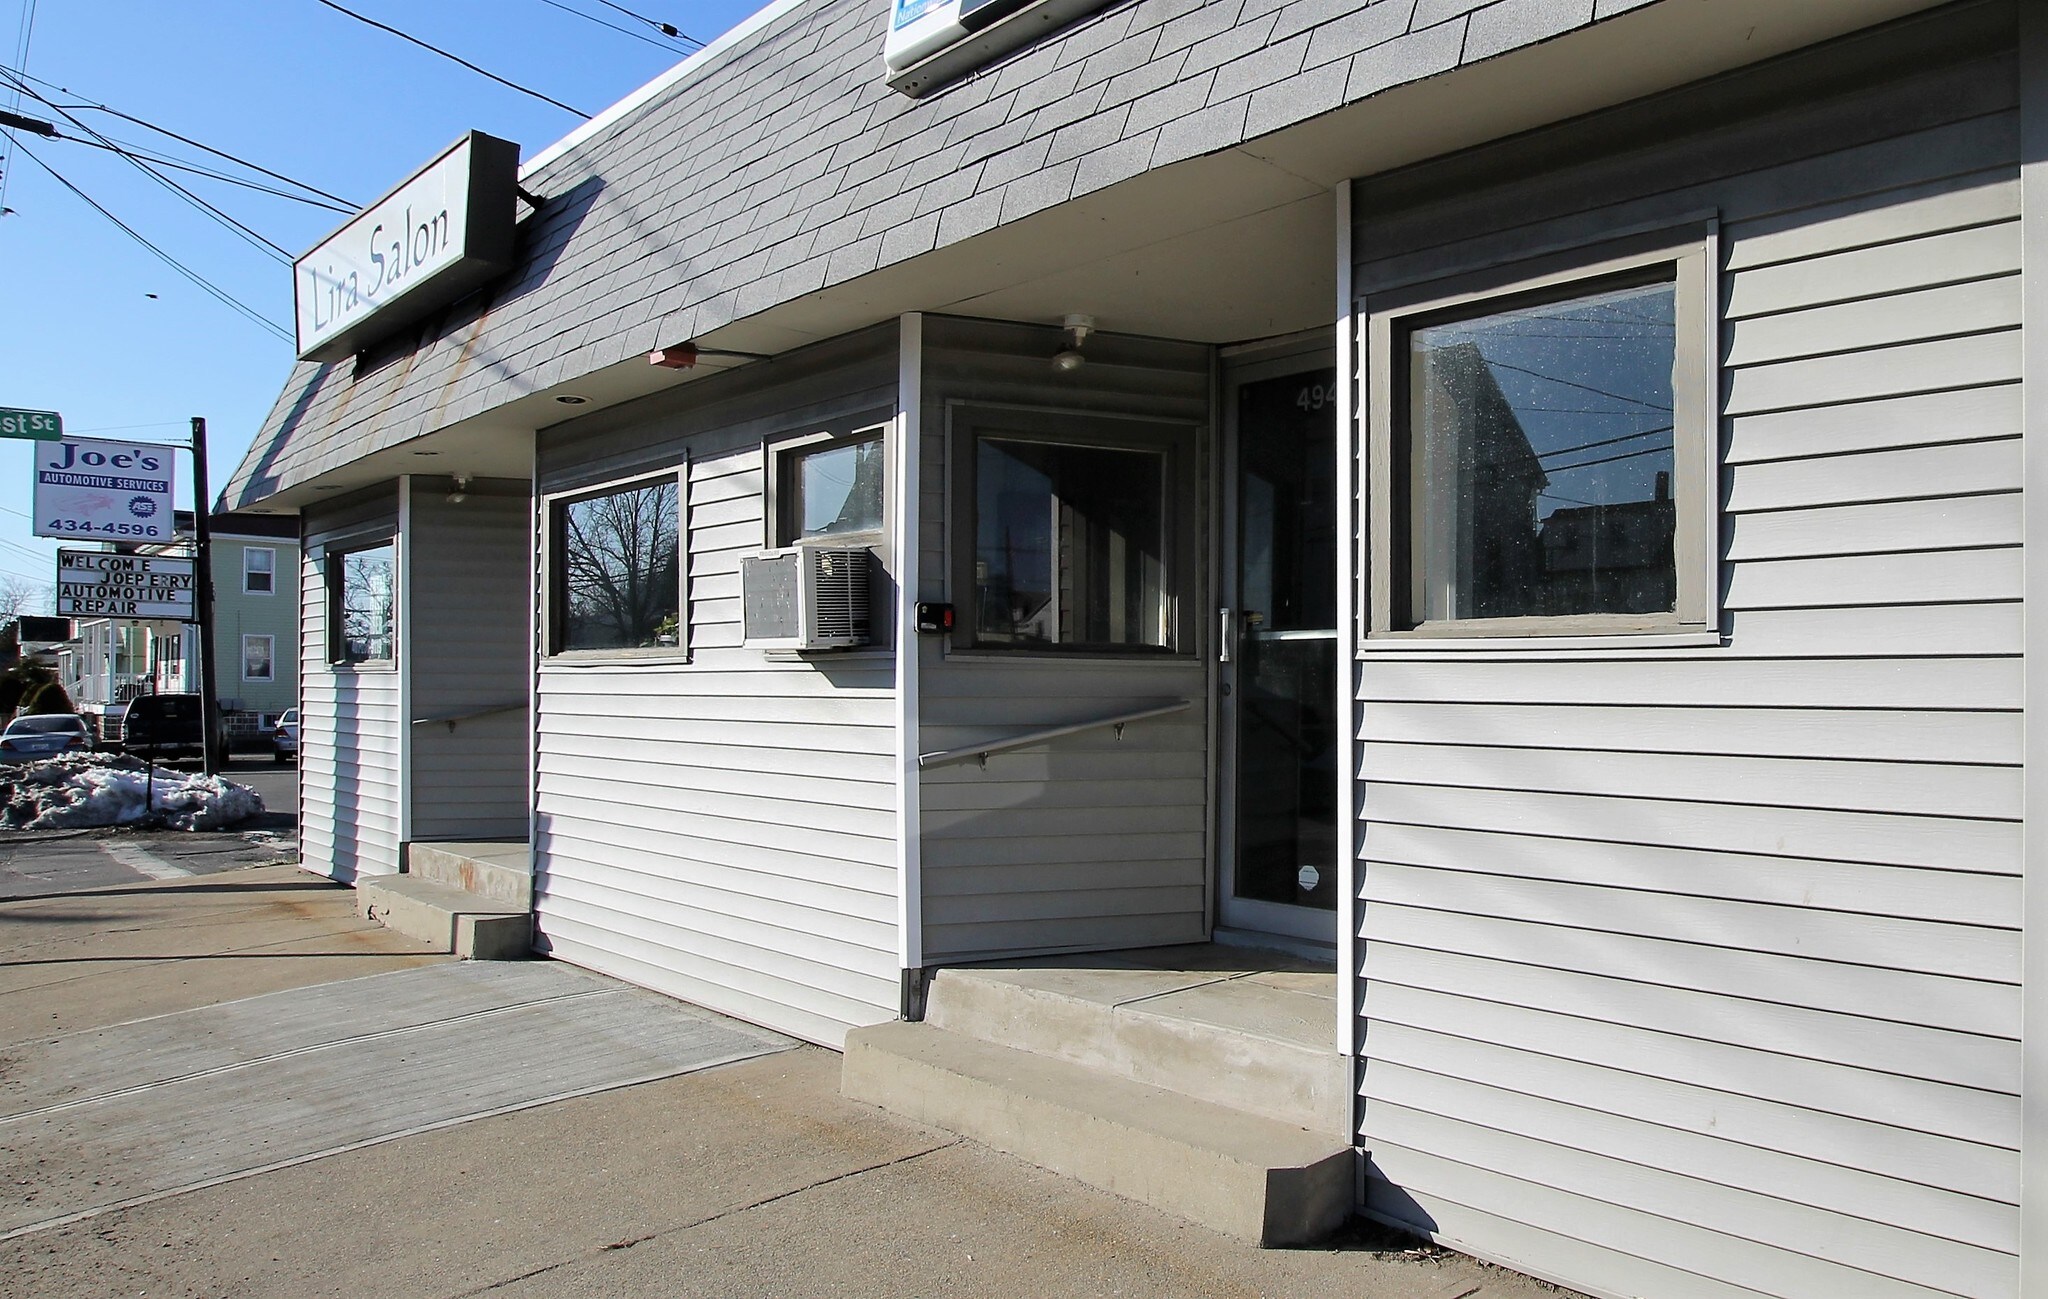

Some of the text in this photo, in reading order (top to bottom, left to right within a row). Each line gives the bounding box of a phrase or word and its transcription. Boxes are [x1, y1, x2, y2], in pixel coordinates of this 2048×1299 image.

[312, 204, 449, 332] Lira Salon
[1297, 382, 1336, 411] 494
[0, 414, 54, 433] st St
[49, 442, 160, 471] Joe's
[44, 473, 164, 491] AUTOMOTIVE SERVICES
[131, 502, 154, 511] ASE
[48, 519, 159, 536] 434-4596
[61, 584, 176, 601] AUTOMOTIVE
[72, 599, 137, 614] REPAIR
